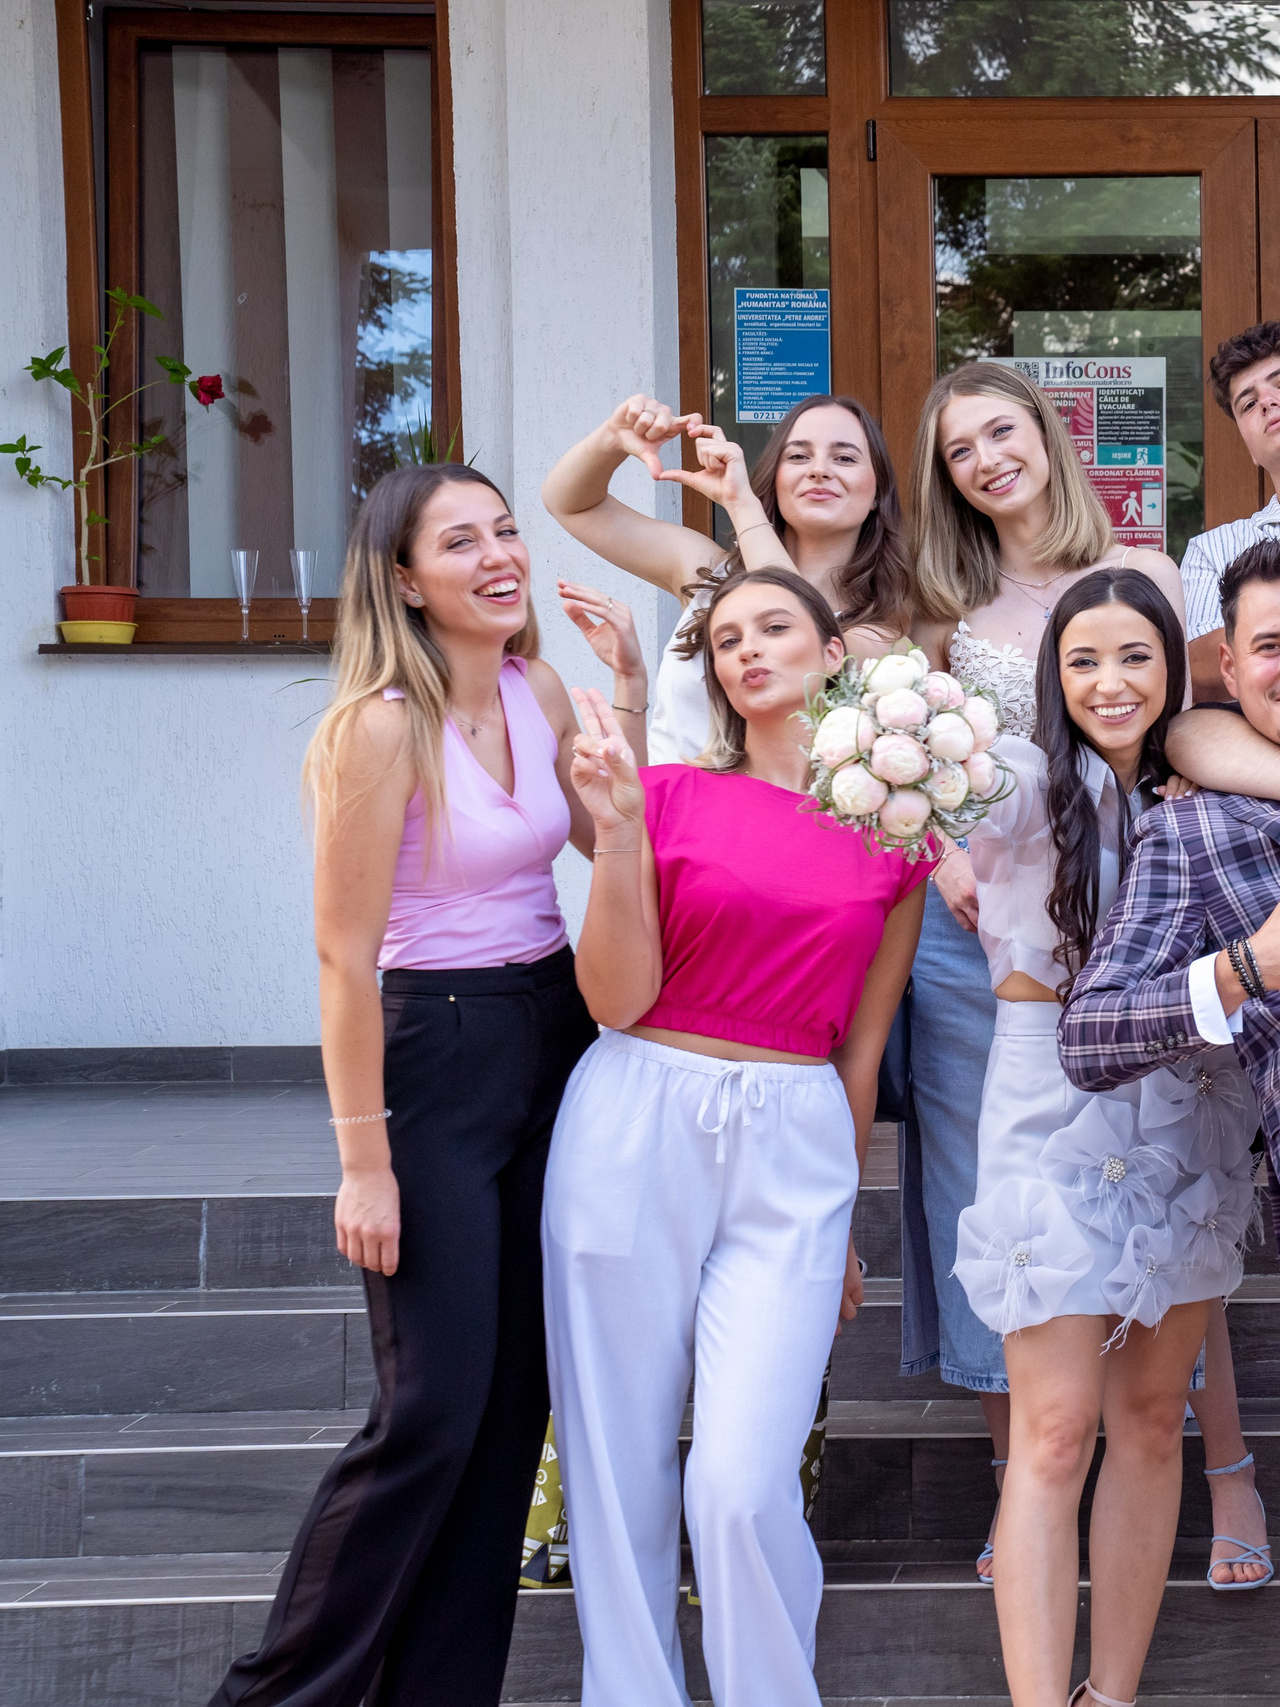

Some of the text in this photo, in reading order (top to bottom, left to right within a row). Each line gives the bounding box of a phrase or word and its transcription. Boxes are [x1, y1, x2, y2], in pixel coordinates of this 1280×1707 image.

[791, 300, 828, 309] ROMÂNIA
[1044, 361, 1132, 379] InfoCons
[1098, 389, 1145, 397] IDENTIFICAȚI
[753, 412, 776, 420] 0721
